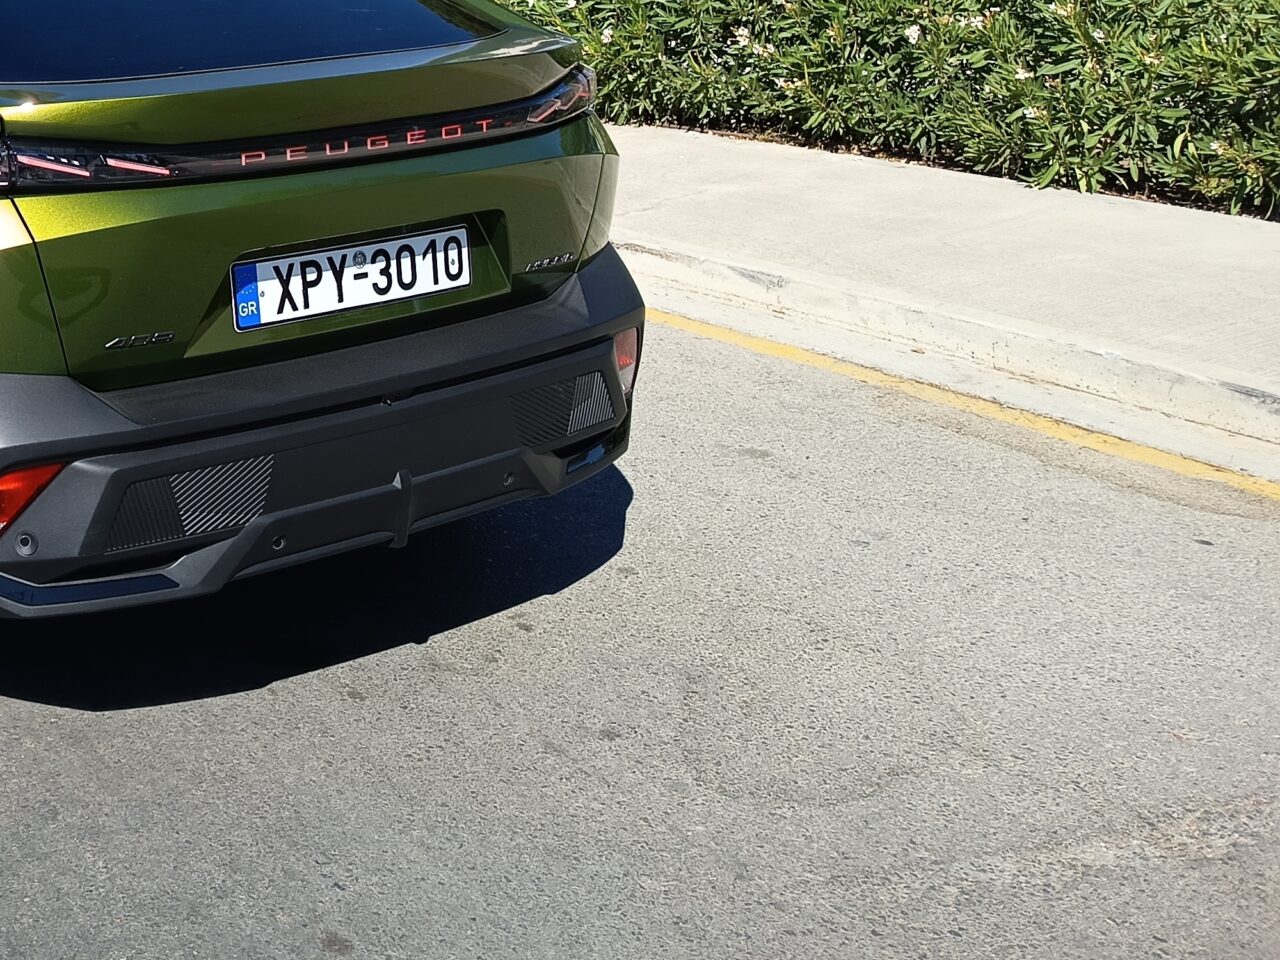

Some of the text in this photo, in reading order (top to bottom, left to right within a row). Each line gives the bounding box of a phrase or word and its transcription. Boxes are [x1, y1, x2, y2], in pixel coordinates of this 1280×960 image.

[240, 119, 493, 166] PEUGEOT
[272, 235, 463, 315] XPY-3010
[239, 300, 258, 317] GR
